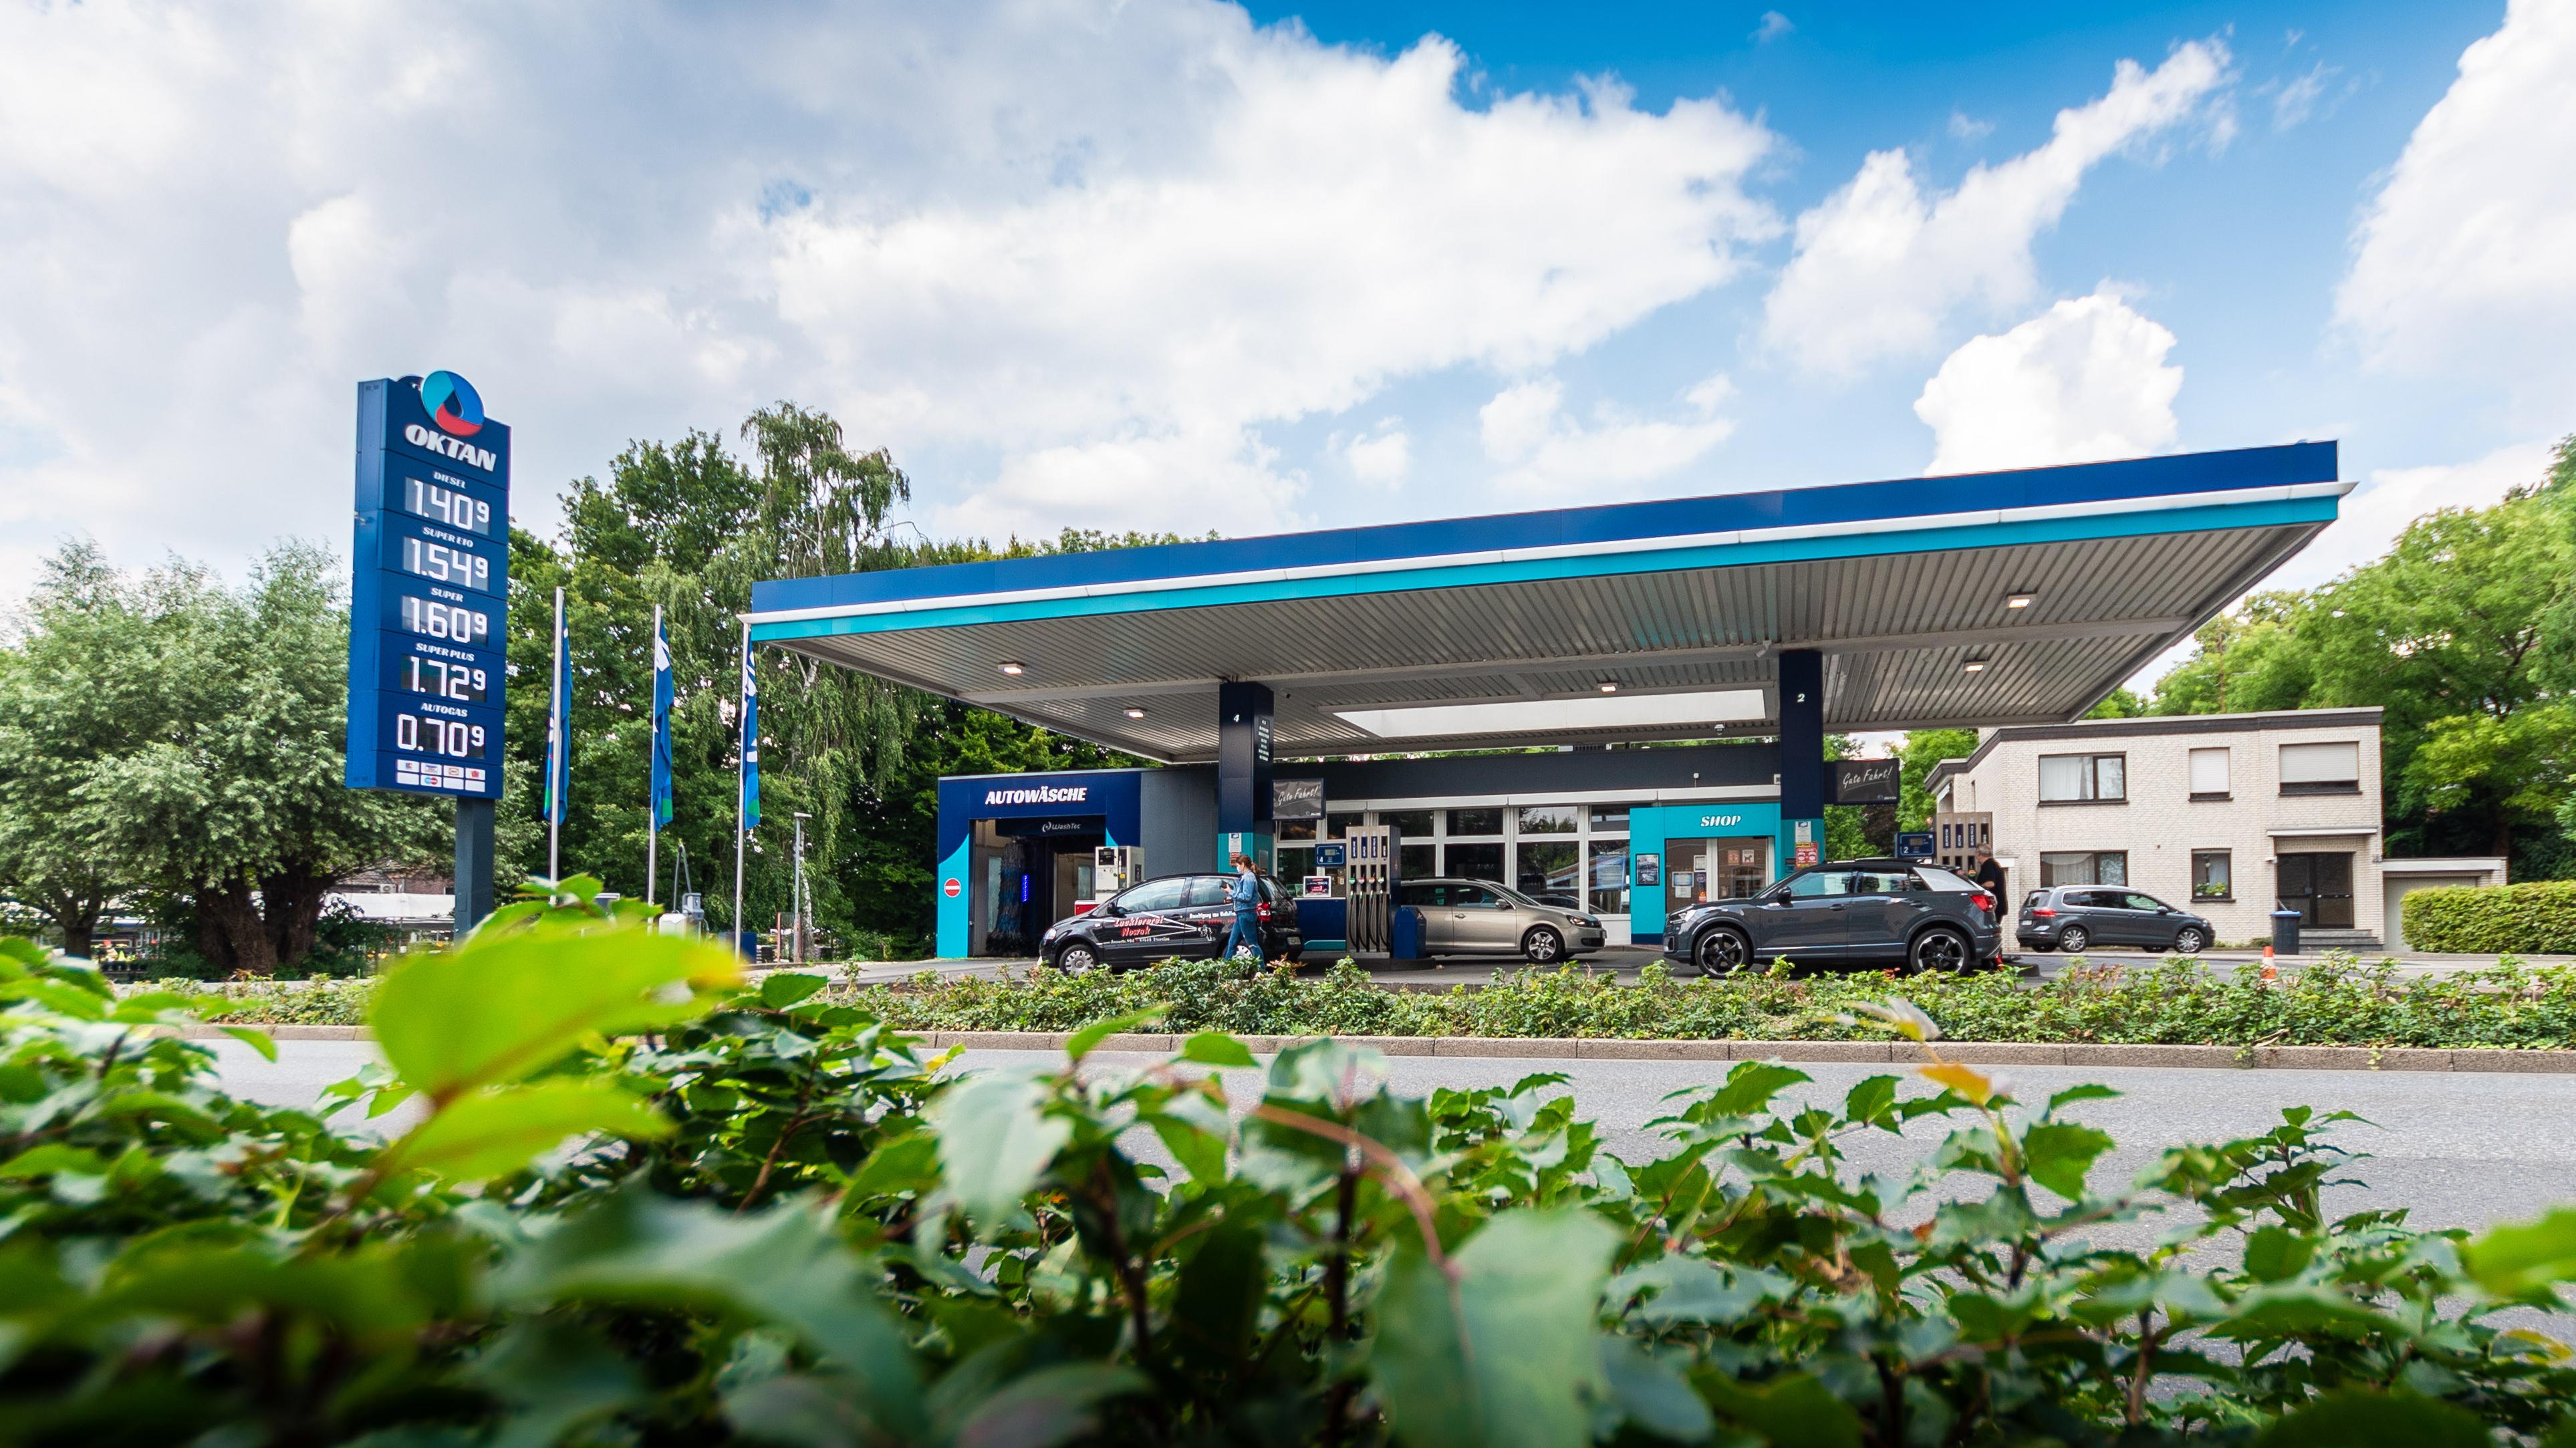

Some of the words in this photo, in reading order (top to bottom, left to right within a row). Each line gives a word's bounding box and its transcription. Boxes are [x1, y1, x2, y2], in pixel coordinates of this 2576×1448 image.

[405, 424, 497, 472] OKTAN
[433, 471, 466, 489] DIESEL
[422, 527, 456, 543] SUPER
[457, 537, 474, 548] E10
[430, 587, 464, 602] SUPER
[416, 643, 448, 656] SUPER
[449, 649, 475, 662] PLUS
[1797, 694, 1805, 702] 2
[420, 702, 468, 718] AUTOGAS
[1233, 714, 1240, 722] 4
[1843, 772, 1861, 789] Gute
[1863, 765, 1893, 782] Fahrt!
[985, 786, 1087, 805] AUTOWÄSCHE
[1051, 823, 1081, 831] WashTec
[1700, 815, 1741, 827] SHOP
